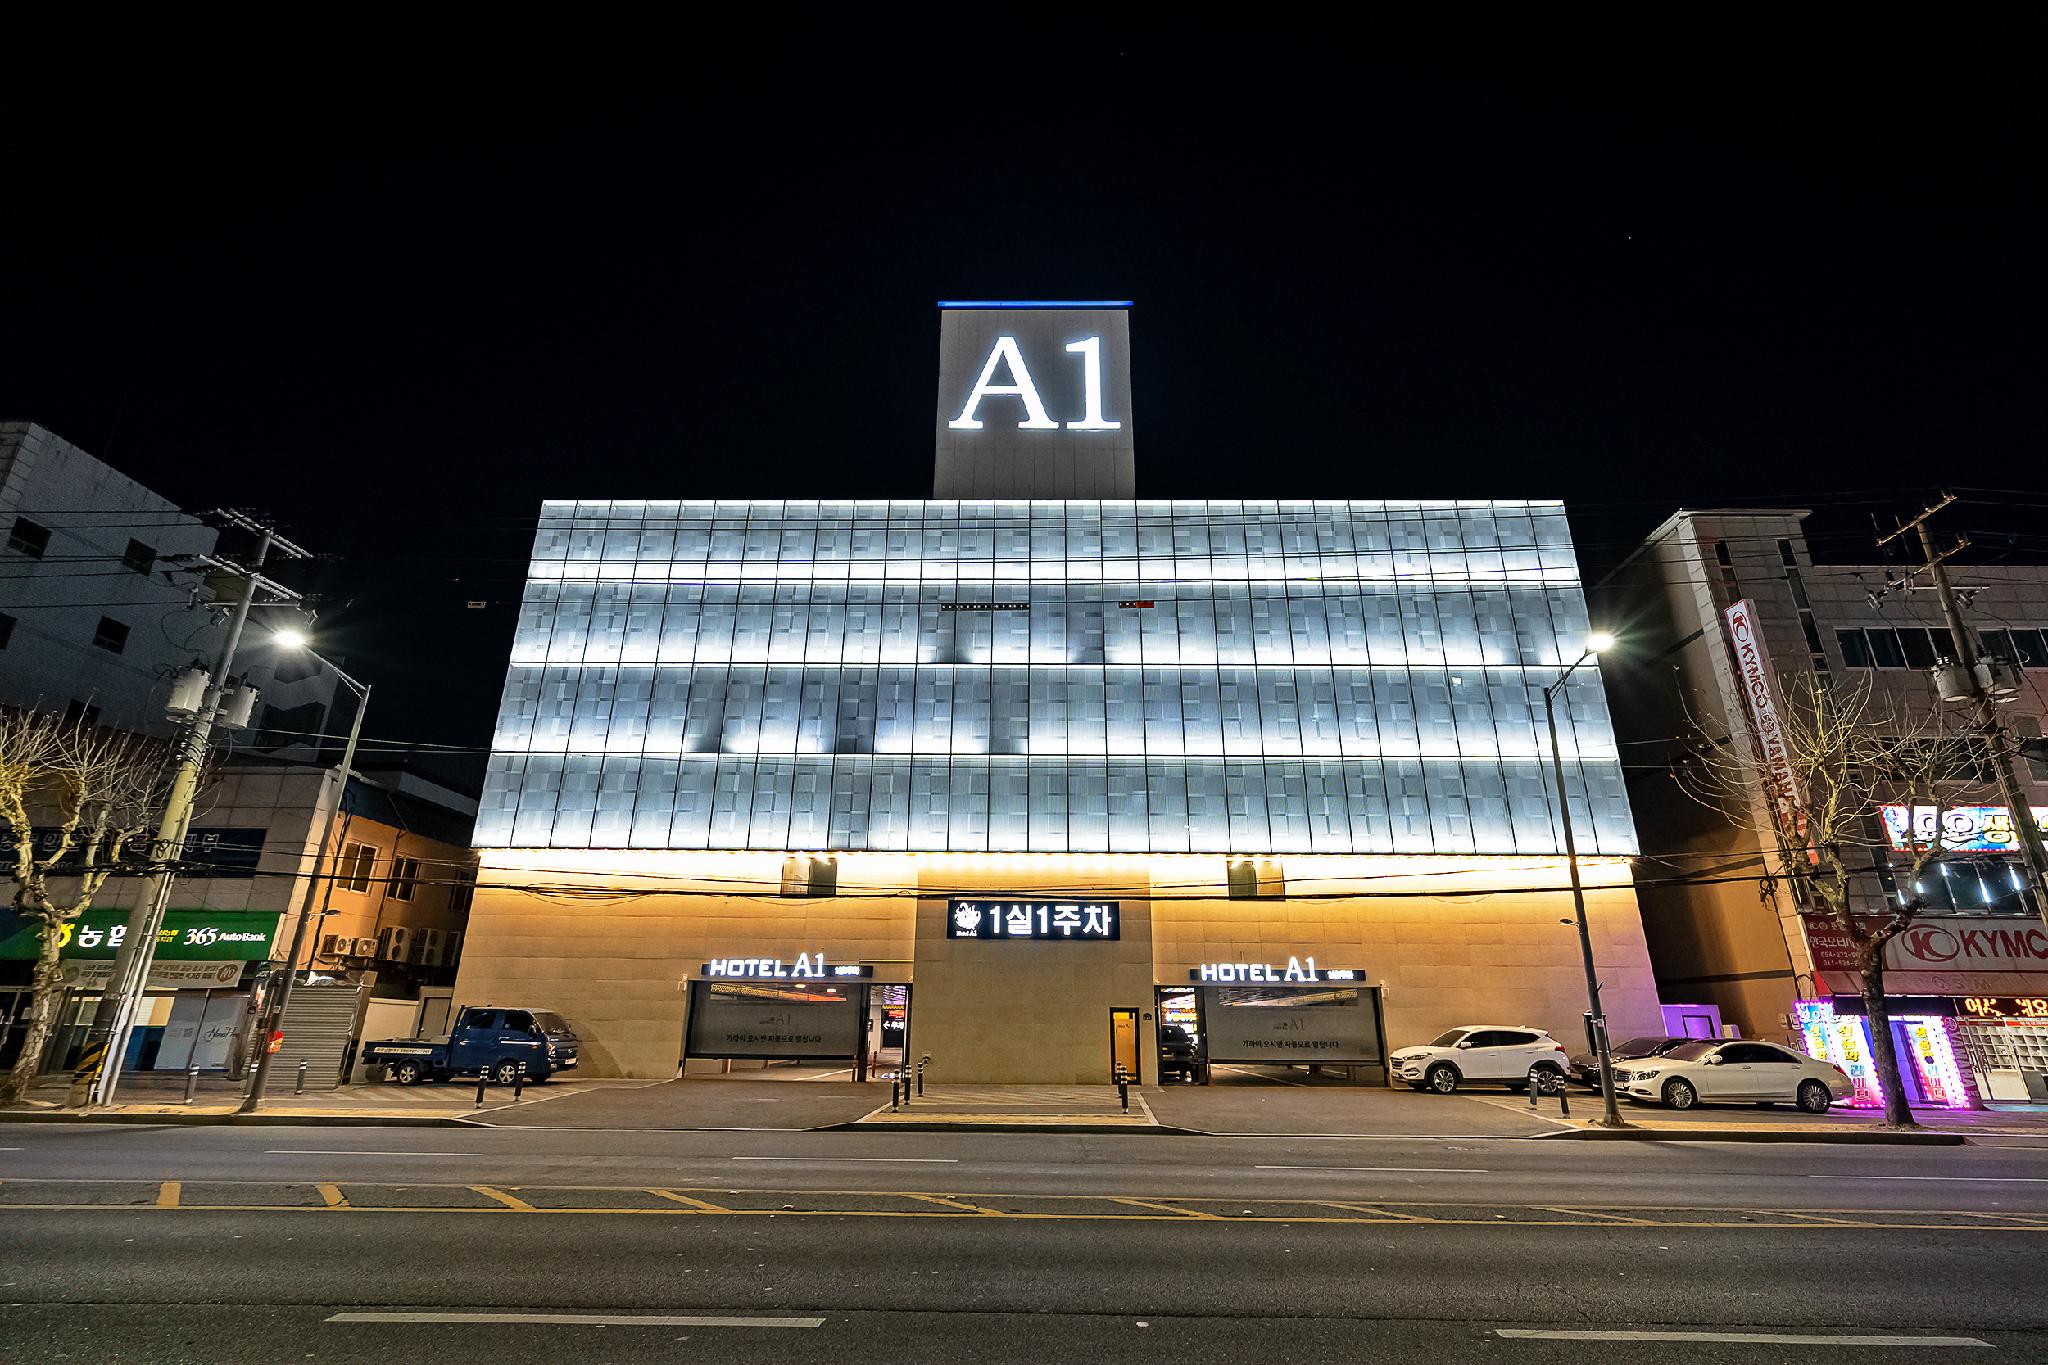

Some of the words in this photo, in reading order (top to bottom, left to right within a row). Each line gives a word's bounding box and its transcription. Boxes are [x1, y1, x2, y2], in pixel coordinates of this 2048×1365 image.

[948, 336, 1121, 431] A1
[1741, 642, 1768, 709] KYMCO
[1767, 735, 1795, 800] YAMAH
[989, 904, 1112, 936] 1실1주차
[183, 927, 218, 946] 365
[217, 932, 266, 942] AutoBank
[1959, 928, 2048, 960] KYMC
[710, 958, 787, 977] HOTEL
[791, 952, 826, 978] A1
[1200, 963, 1280, 981] HOTEL
[1284, 956, 1320, 981] A1
